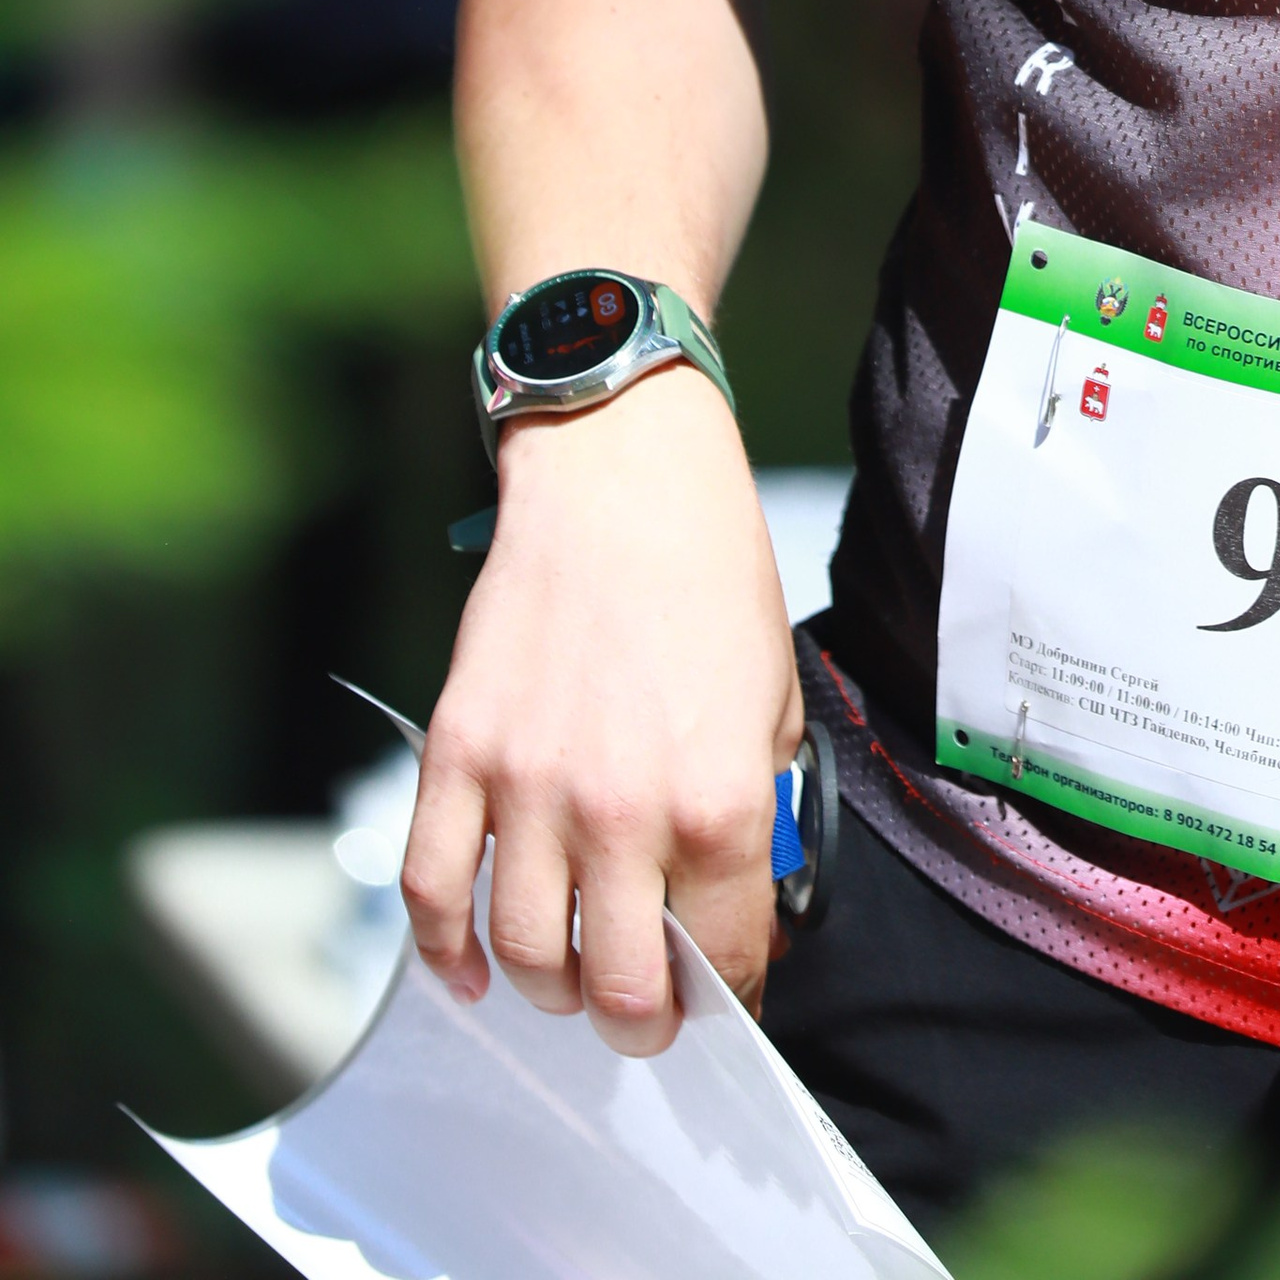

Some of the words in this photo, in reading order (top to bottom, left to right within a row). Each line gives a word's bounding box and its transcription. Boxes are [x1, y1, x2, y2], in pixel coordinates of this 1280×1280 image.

[598, 292, 618, 317] GO
[1186, 336, 1206, 353] по
[1009, 651, 1047, 677] Старт:
[1052, 667, 1104, 695] 11:09:00
[1117, 689, 1170, 716] 11:00:00
[1183, 709, 1241, 737] 10:14:00
[1245, 726, 1280, 748] Чип:
[1036, 642, 1107, 676] Добрынин
[1110, 666, 1159, 692] Сергей
[1008, 670, 1075, 706] Коллектив:
[1078, 696, 1106, 716] СШ
[1110, 705, 1138, 727] ЧТЗ
[1142, 717, 1210, 751] Гайденко,
[990, 745, 1049, 778] Телфон
[1052, 771, 1159, 818] организаторов:
[1164, 809, 1172, 822] 8
[1177, 813, 1203, 832] 902
[1207, 822, 1232, 842] 472
[1237, 833, 1254, 848] 18
[1258, 839, 1277, 855] 54
